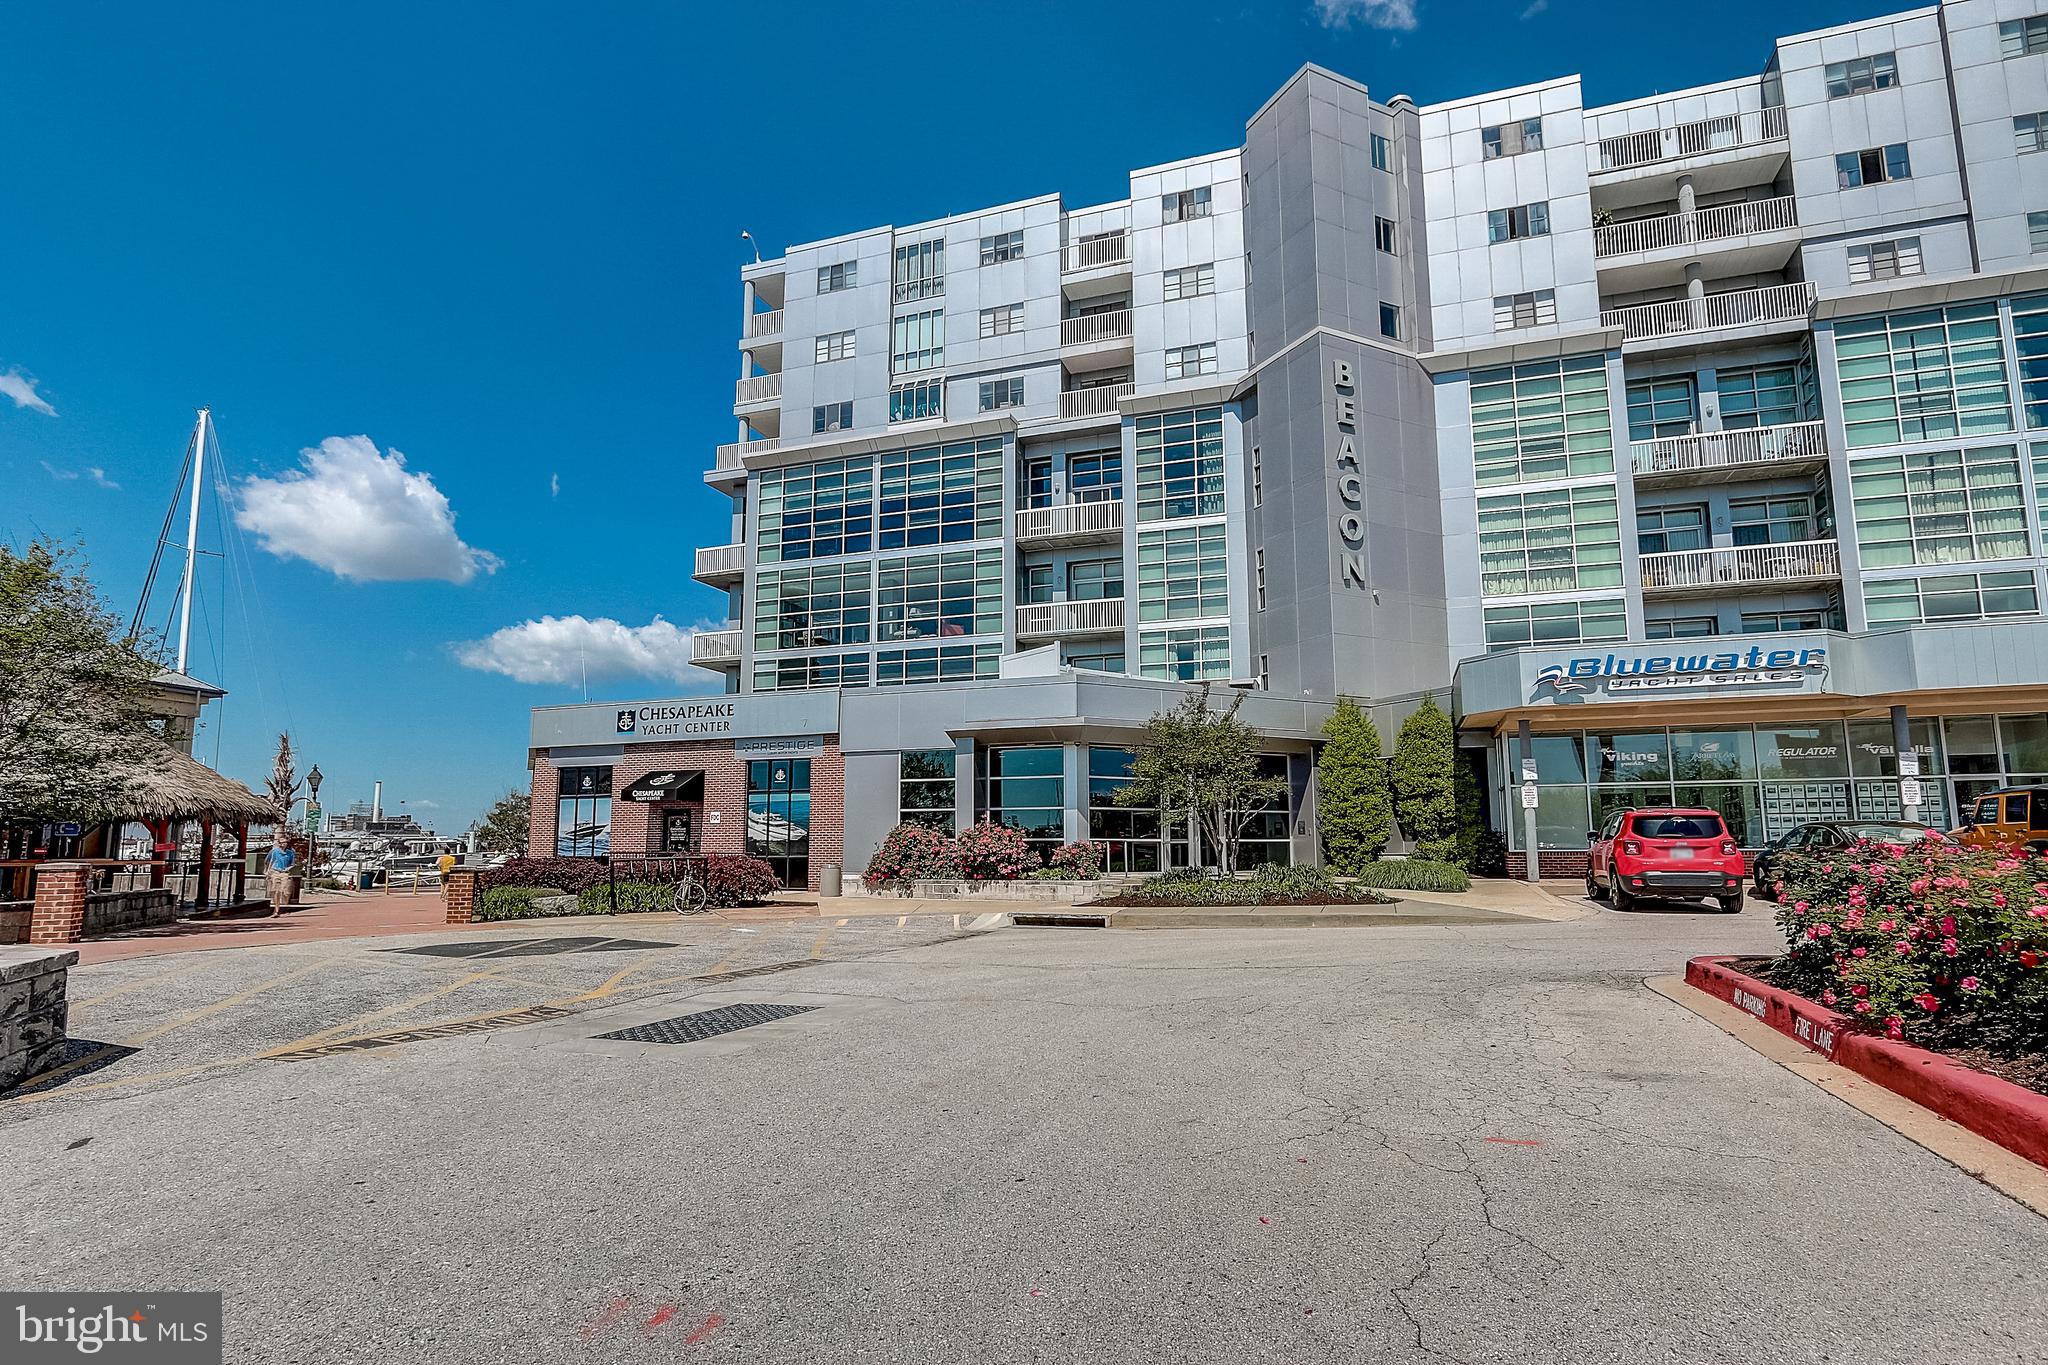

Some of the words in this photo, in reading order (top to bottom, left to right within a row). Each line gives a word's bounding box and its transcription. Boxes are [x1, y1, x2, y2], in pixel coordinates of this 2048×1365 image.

[1333, 359, 1365, 582] BEACON
[1567, 645, 1826, 678] Bluewater
[1611, 677, 1696, 688] YACHT
[1715, 671, 1805, 683] SALES
[639, 703, 735, 721] CHESAPEAKE
[642, 723, 680, 735] YACHT
[685, 721, 730, 733] CENTER
[752, 740, 815, 751] PRESTIGE
[1768, 746, 1837, 757] REGULATOR
[1733, 987, 1742, 1005] NO
[1742, 991, 1767, 1018] PARKING
[1795, 1016, 1812, 1040] FIRE
[1813, 1025, 1834, 1052] LANE
